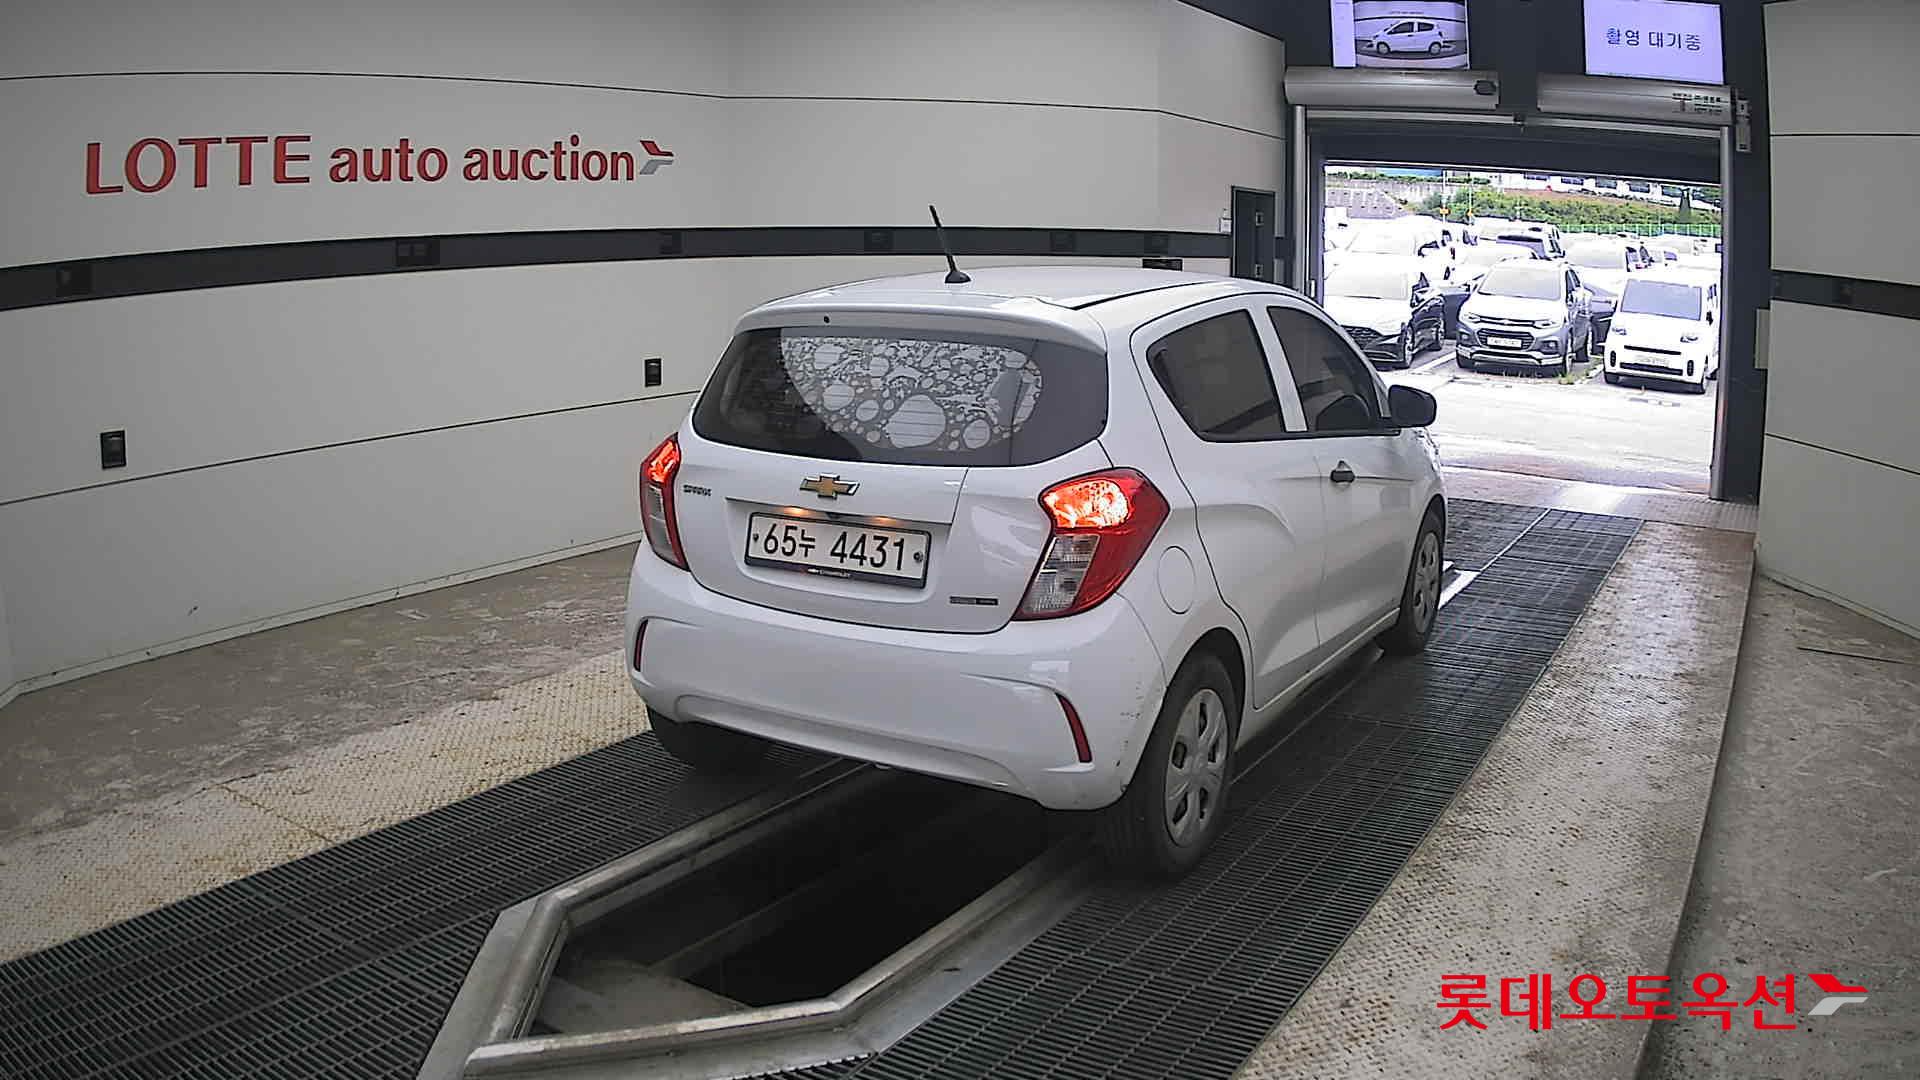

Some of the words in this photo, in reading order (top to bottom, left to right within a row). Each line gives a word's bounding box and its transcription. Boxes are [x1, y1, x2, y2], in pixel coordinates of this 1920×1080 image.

[1607, 27, 1640, 47] 촬영
[1648, 31, 1701, 52] 대기중
[85, 135, 311, 195] LOTTE
[328, 138, 448, 183] auto
[462, 134, 635, 182] auction
[763, 523, 816, 559] 65누
[829, 531, 906, 572] 4431
